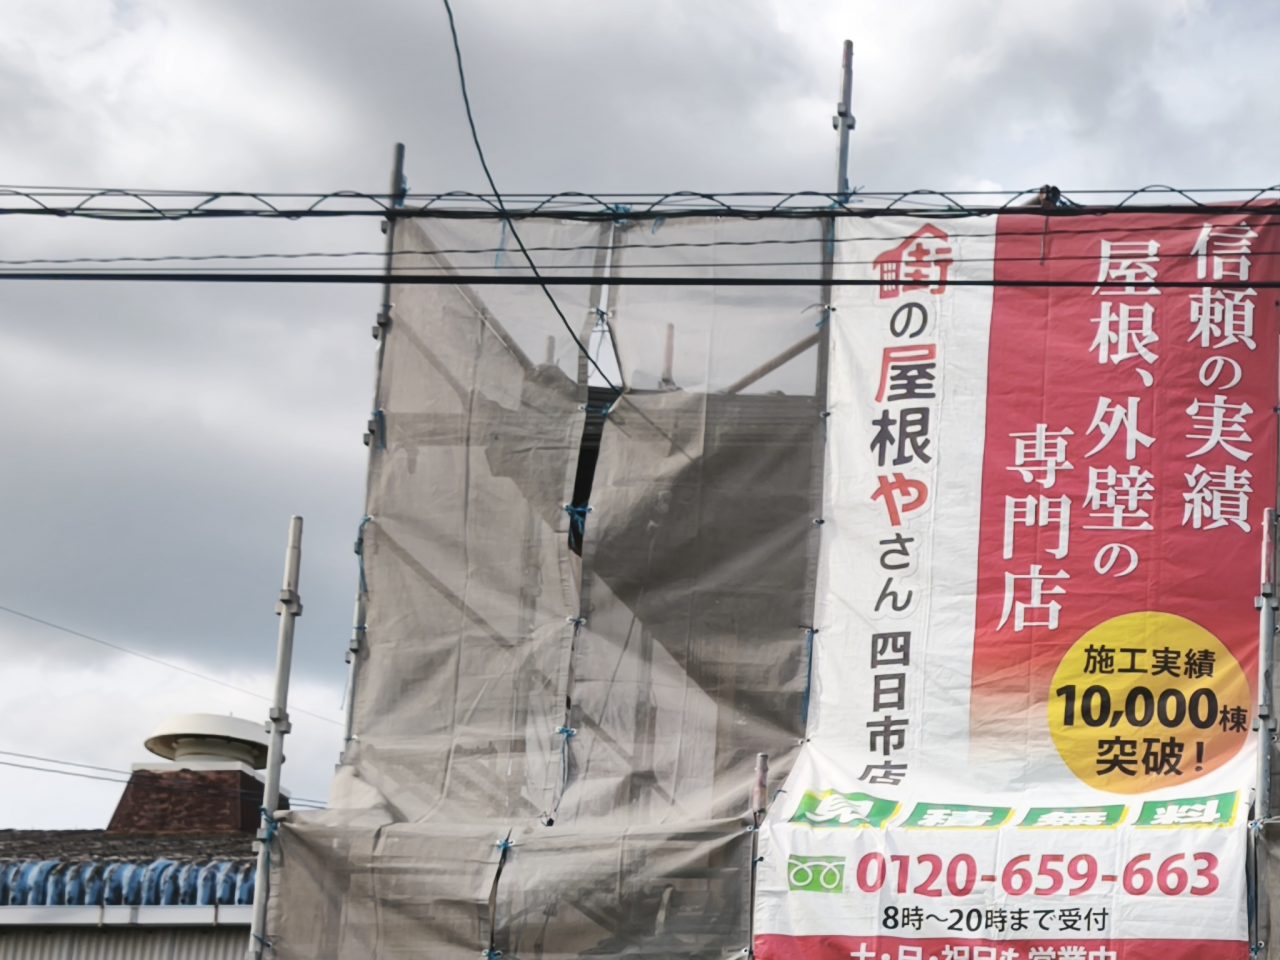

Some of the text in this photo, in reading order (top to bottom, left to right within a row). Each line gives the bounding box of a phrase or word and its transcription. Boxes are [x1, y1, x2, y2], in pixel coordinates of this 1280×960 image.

[1181, 222, 1258, 533] 信頼の実績
[995, 423, 1074, 632] 専門店
[857, 630, 911, 786] 四日市店
[1083, 643, 1216, 680] 施工実績
[855, 851, 1220, 897] 0120-659-663
